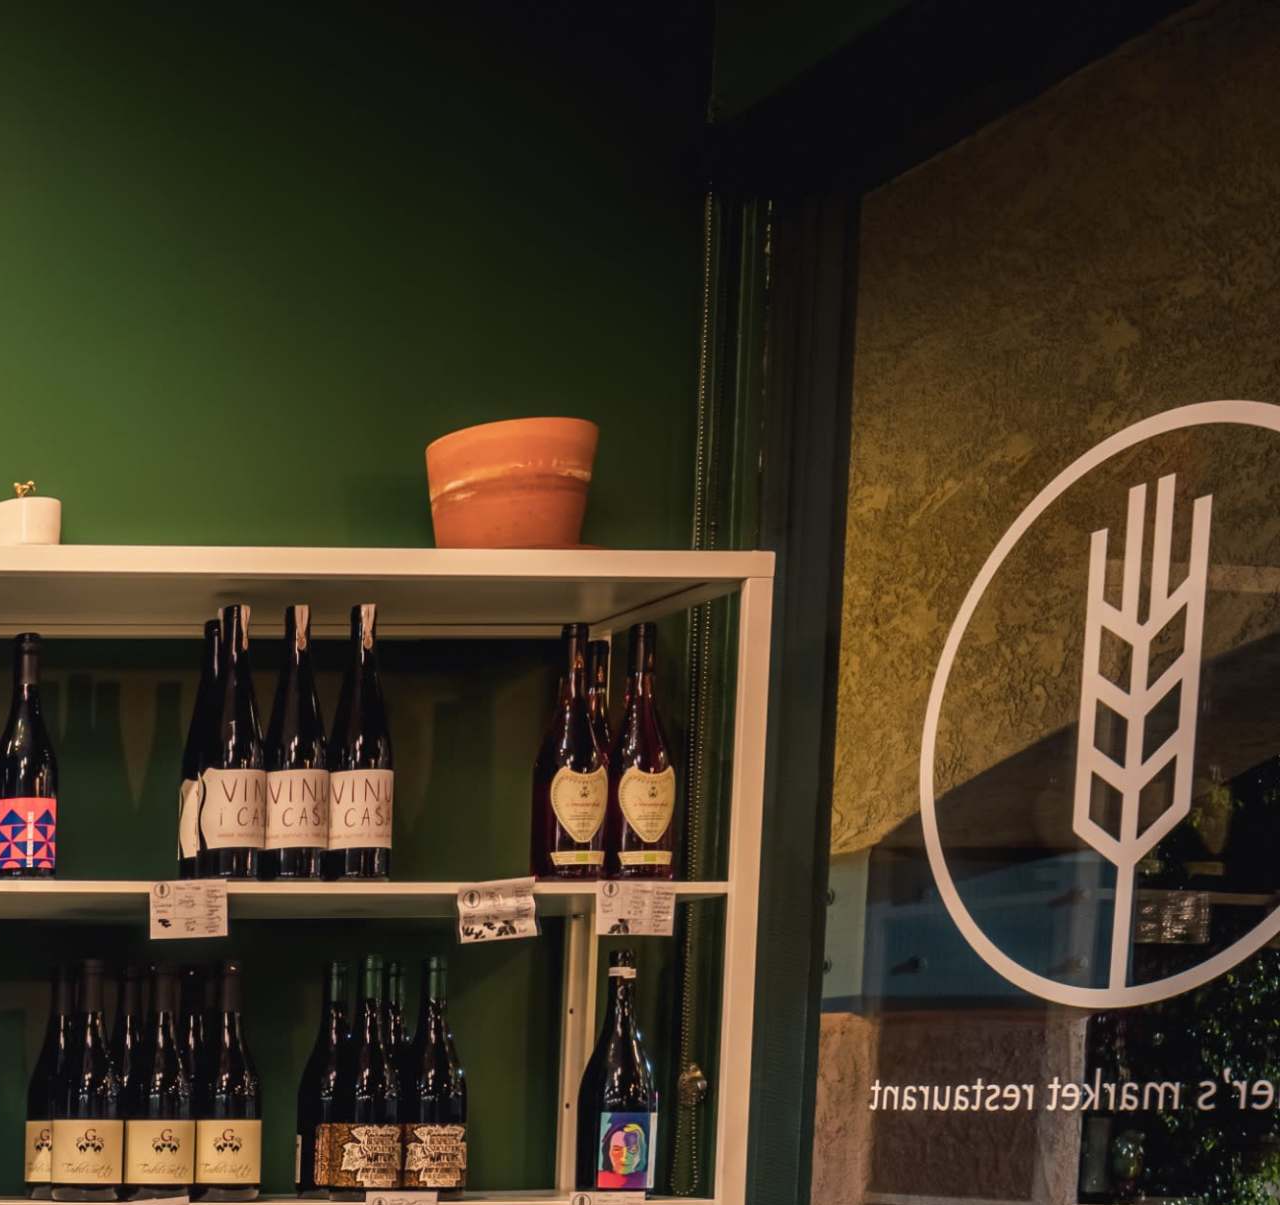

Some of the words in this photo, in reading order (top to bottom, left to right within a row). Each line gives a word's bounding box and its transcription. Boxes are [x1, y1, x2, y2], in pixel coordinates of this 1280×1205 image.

[85, 1129, 97, 1142] G
[160, 1129, 173, 1142] G
[222, 1129, 235, 1142] G
